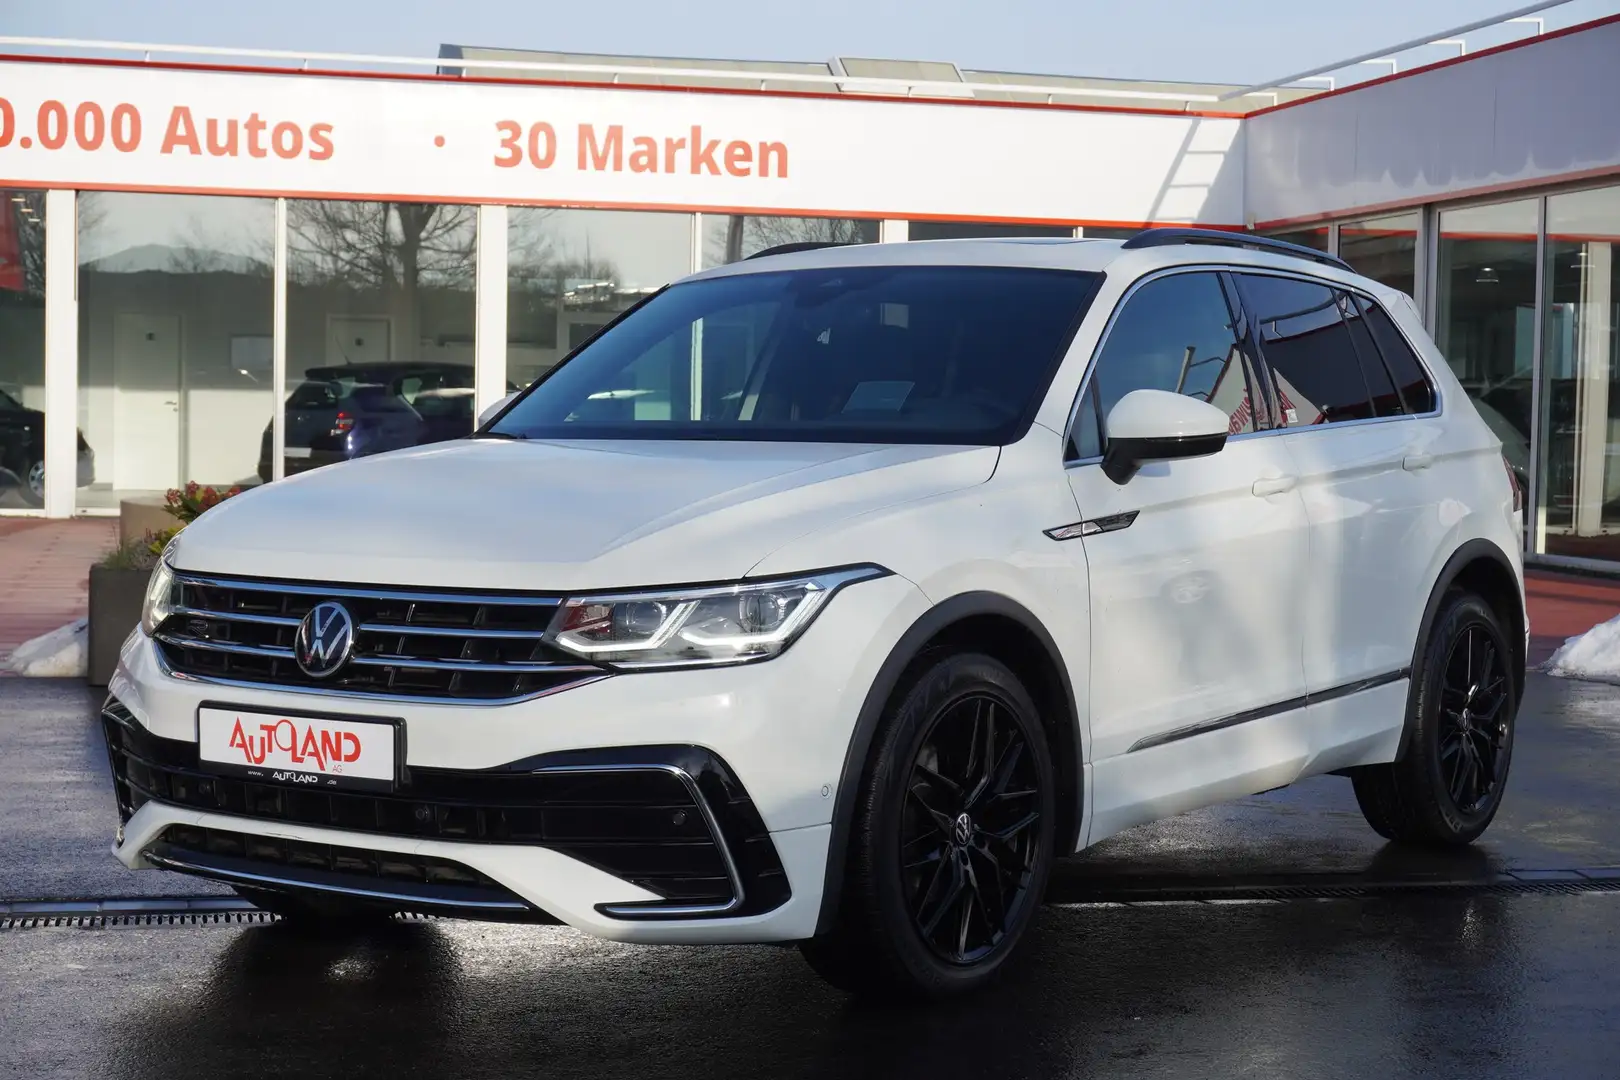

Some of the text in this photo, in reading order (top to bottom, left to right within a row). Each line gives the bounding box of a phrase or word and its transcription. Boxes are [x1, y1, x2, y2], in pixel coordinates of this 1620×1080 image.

[161, 105, 334, 162] Autos
[493, 120, 557, 170] 30
[577, 123, 789, 179] Marken
[229, 717, 362, 772] AUTOLAND
[332, 764, 343, 774] AG
